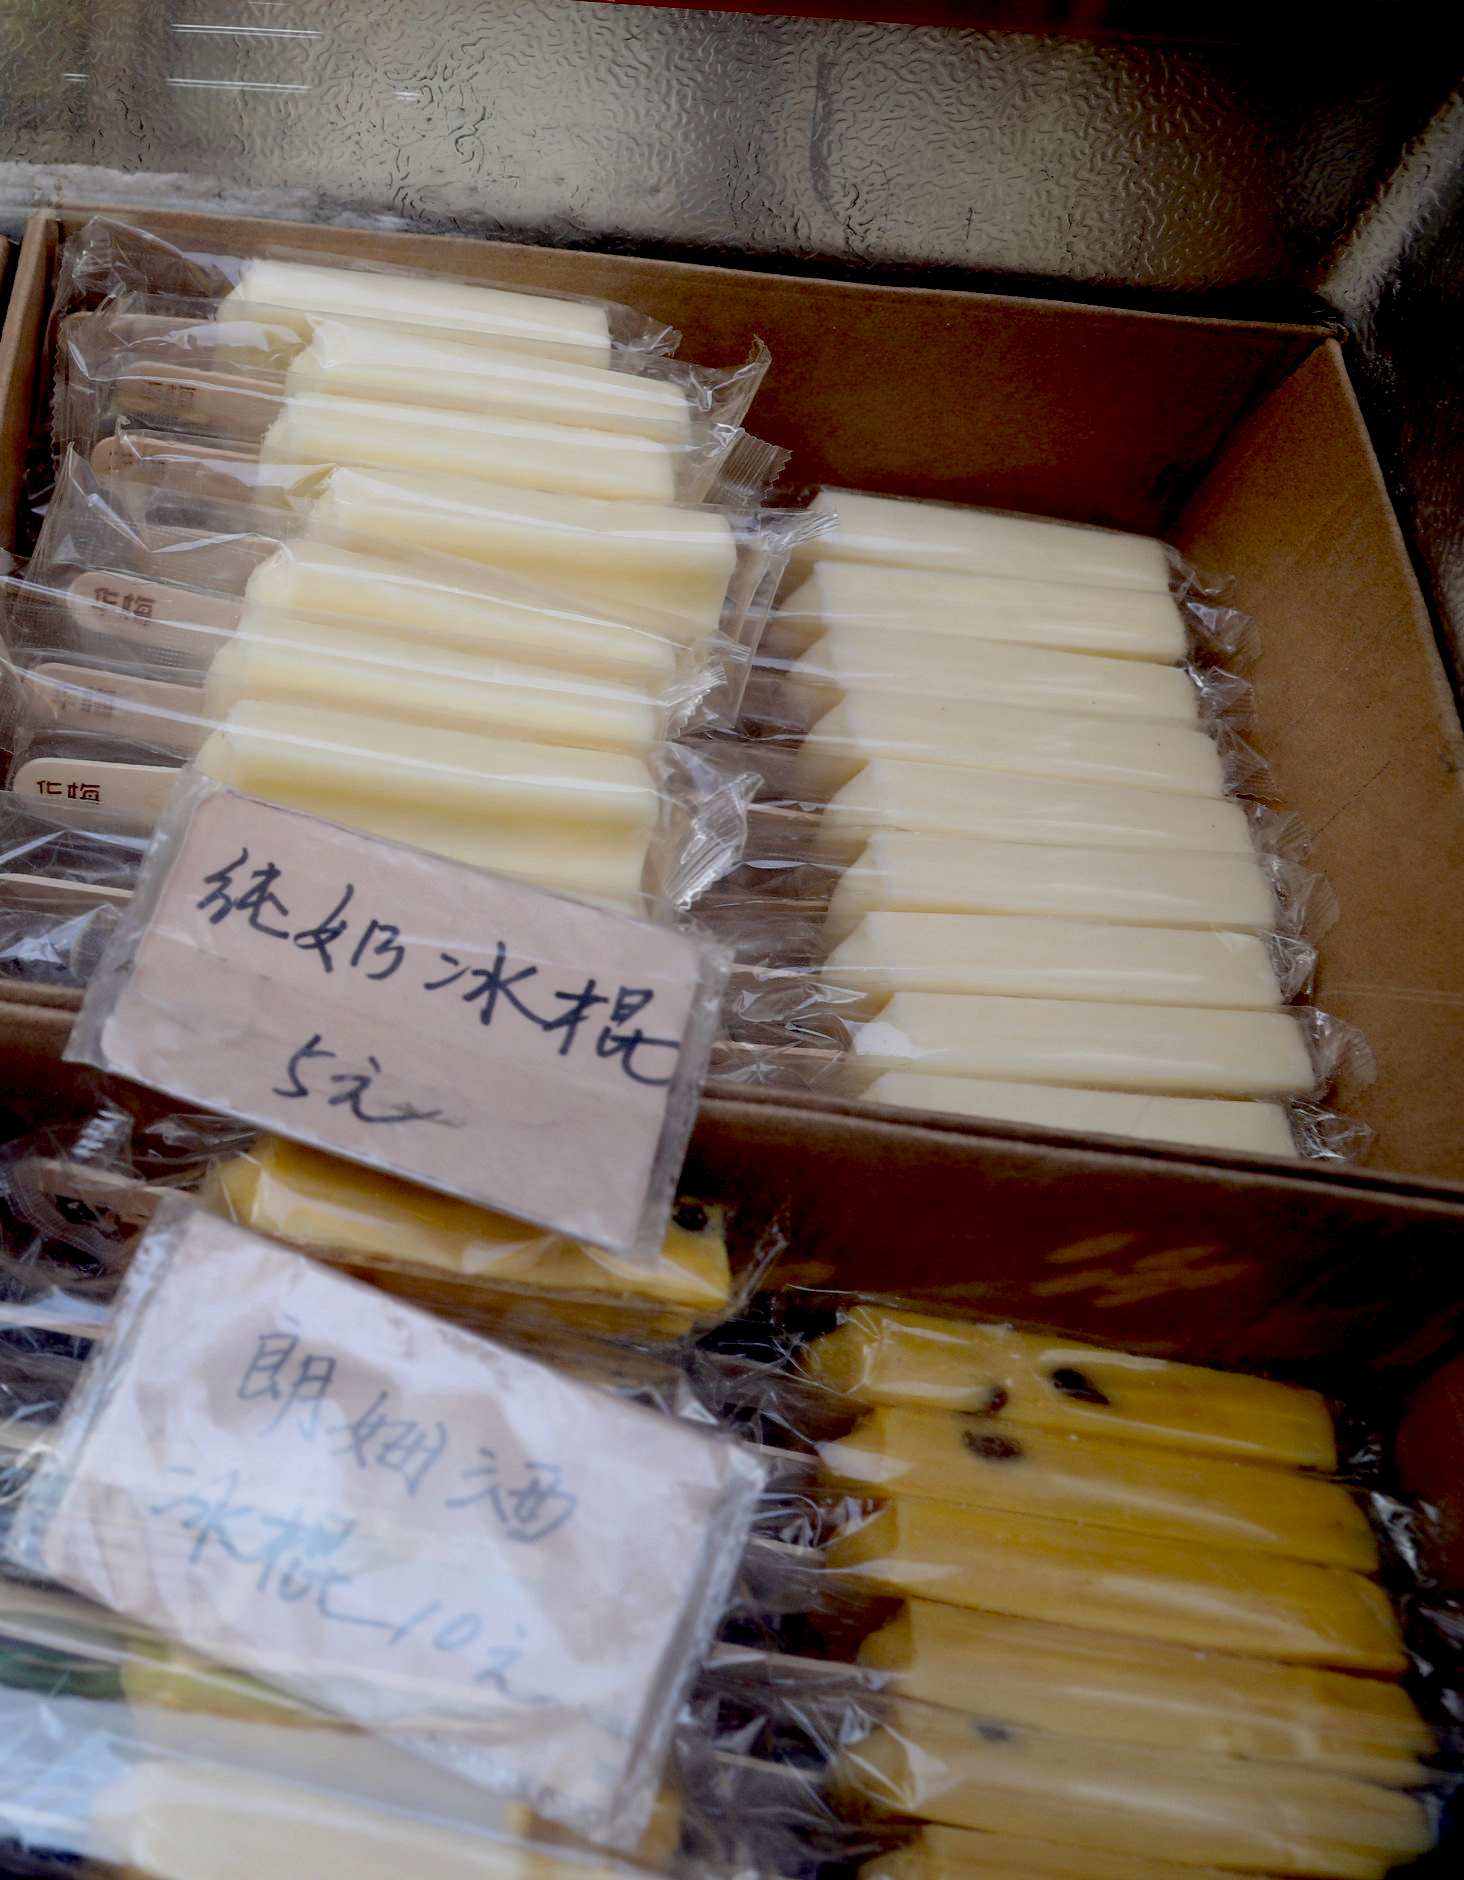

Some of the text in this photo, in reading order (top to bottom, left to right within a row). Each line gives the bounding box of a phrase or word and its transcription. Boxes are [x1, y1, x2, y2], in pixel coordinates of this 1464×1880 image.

[196, 846, 682, 1087] 纯奶冰棍
[272, 1033, 446, 1124] 5元
